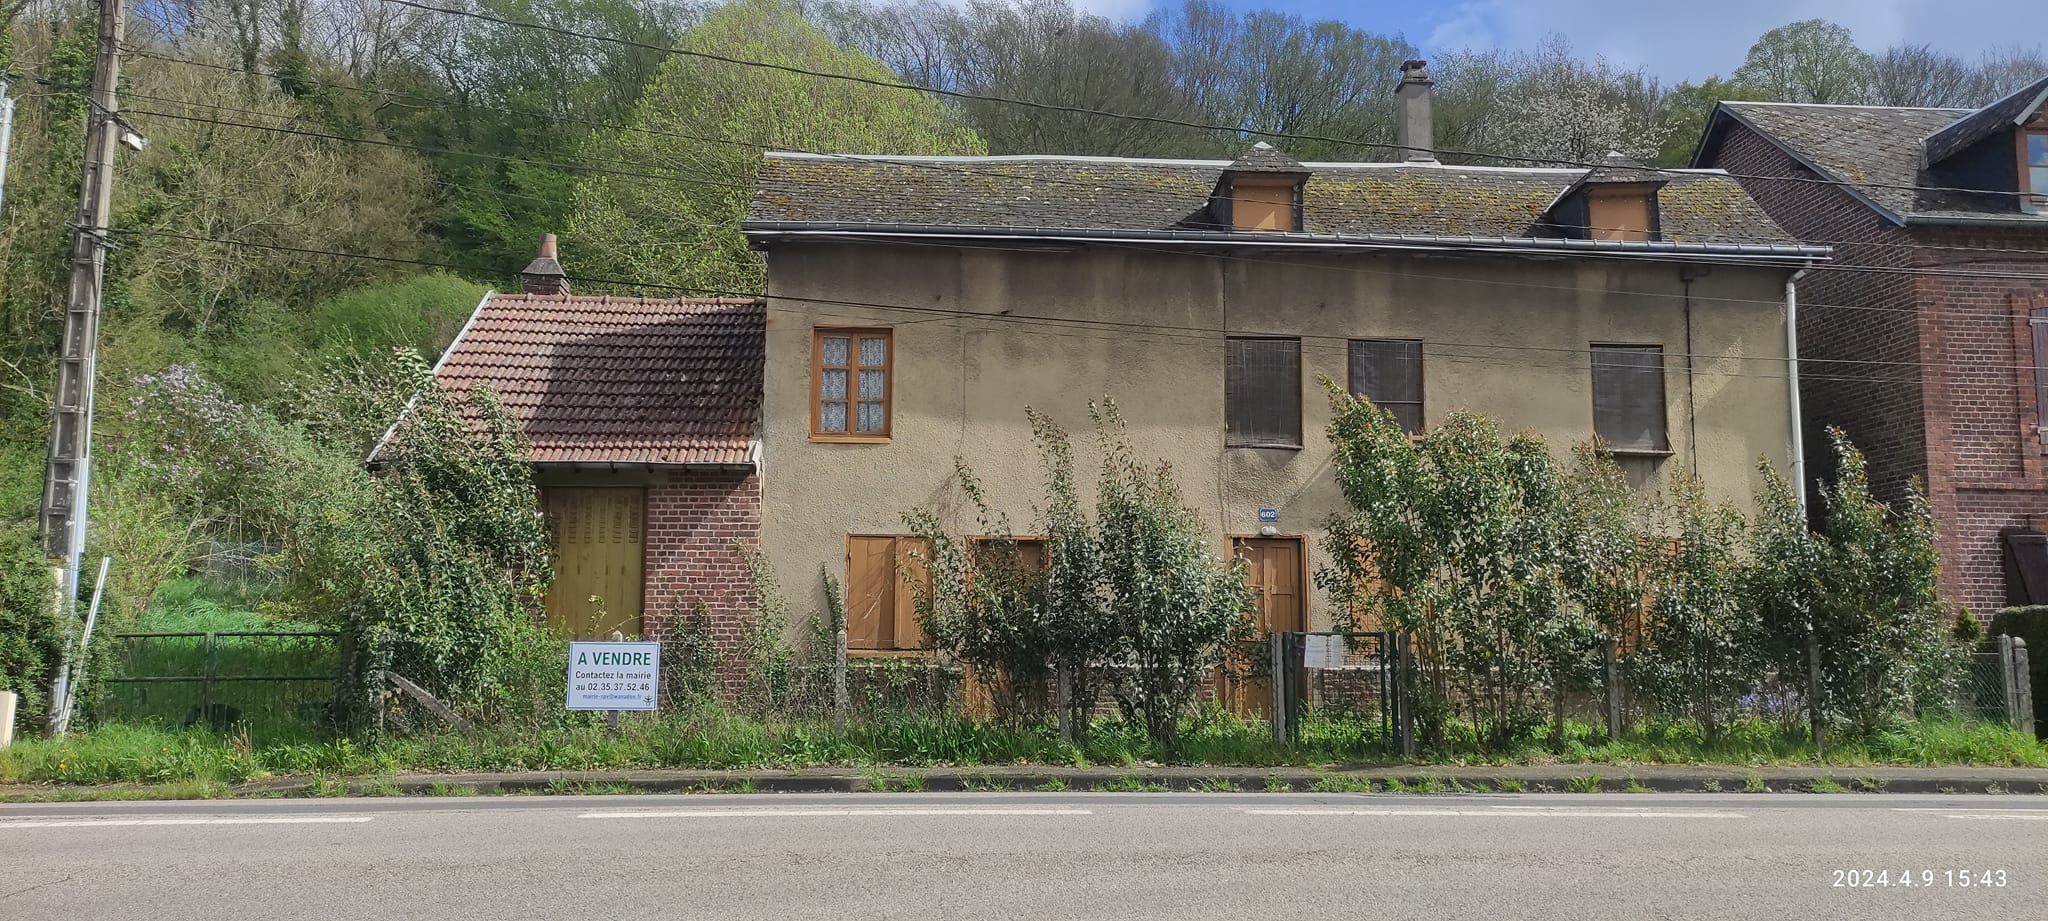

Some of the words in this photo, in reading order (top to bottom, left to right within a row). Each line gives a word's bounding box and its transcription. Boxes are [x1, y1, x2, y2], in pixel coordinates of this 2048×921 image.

[577, 652, 588, 666] A
[592, 652, 651, 666] VENDRE
[575, 671, 614, 680] Contactez
[616, 671, 624, 679] la
[626, 671, 651, 679] mairie
[588, 683, 650, 691] 02.35.37.52.46
